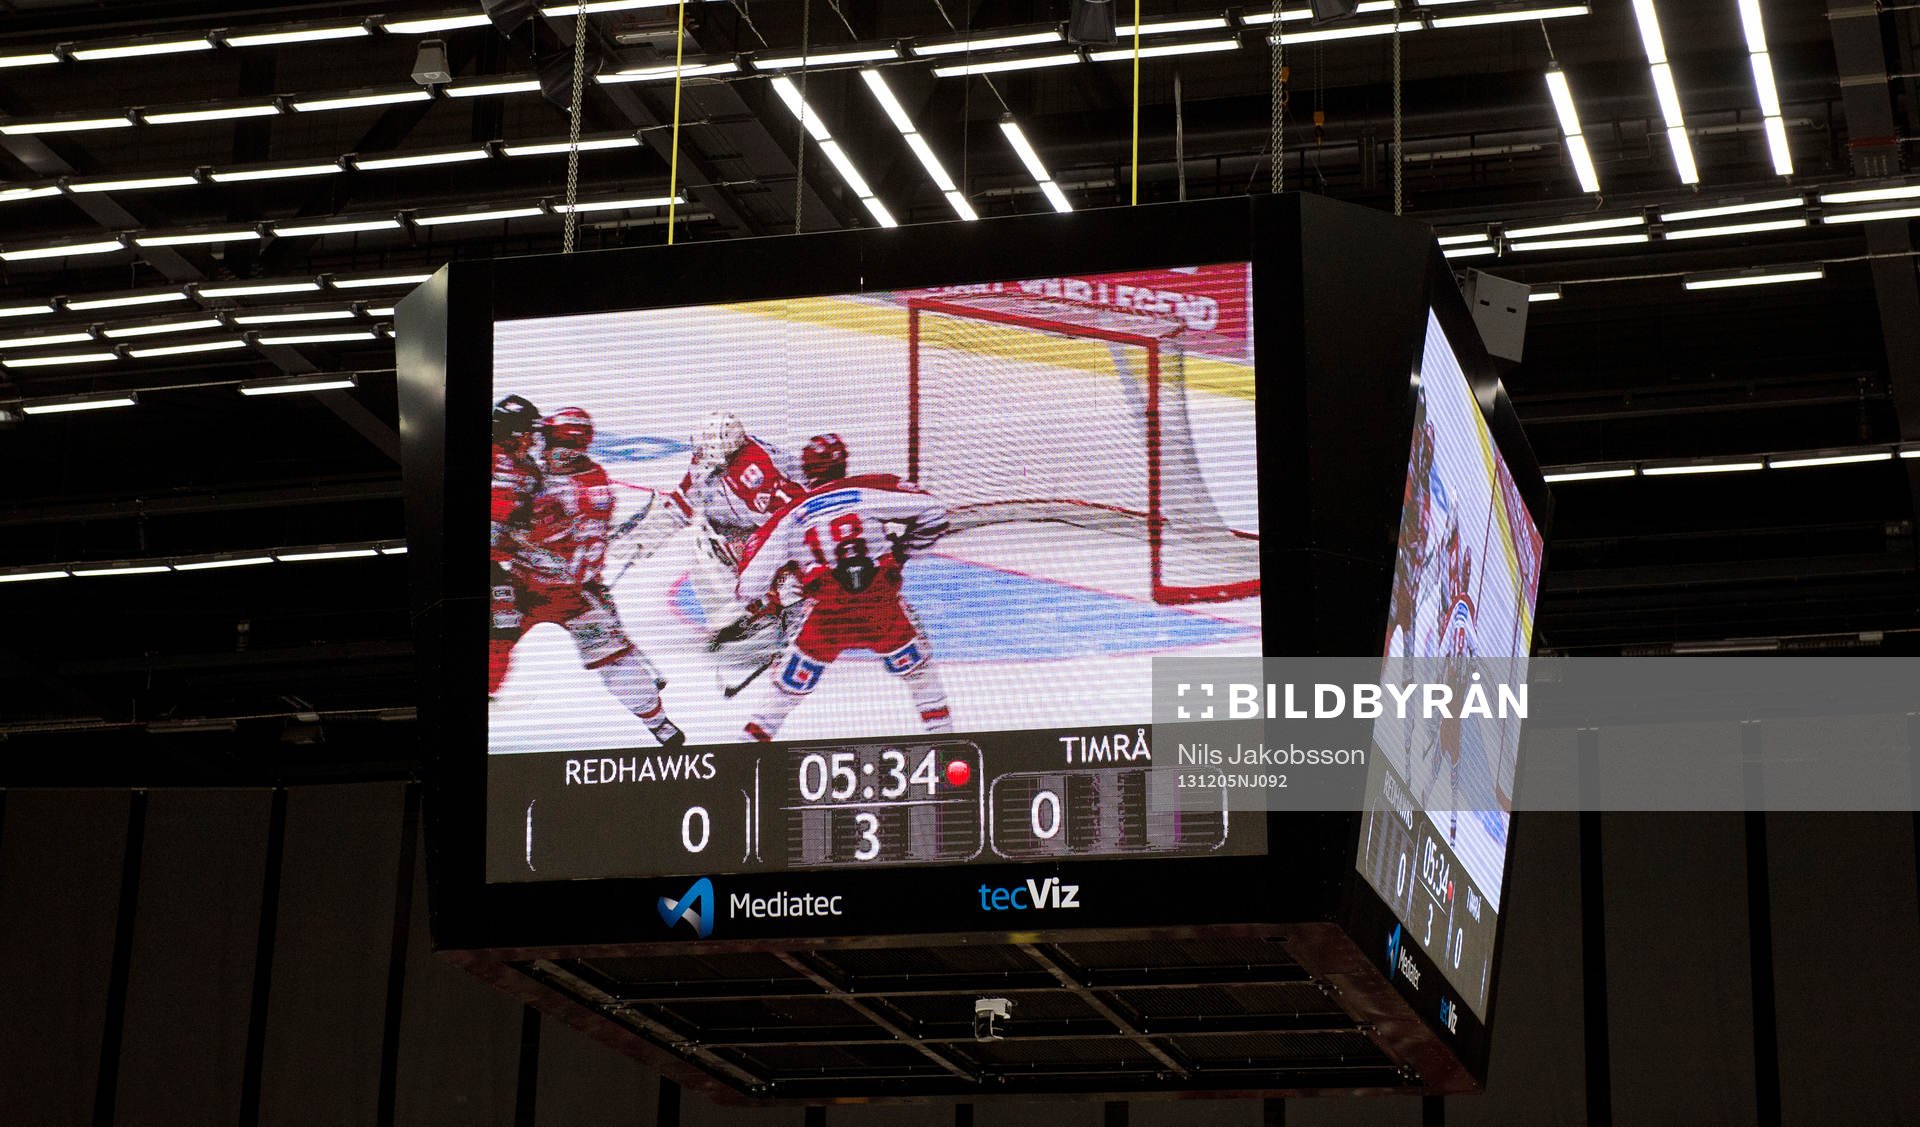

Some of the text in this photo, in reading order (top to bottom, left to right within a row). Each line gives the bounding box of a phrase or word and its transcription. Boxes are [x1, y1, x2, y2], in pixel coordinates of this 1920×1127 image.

[565, 752, 717, 786] REDHAWKS
[1059, 728, 1152, 764] TIMRÅ
[798, 750, 940, 801] 05:34
[681, 806, 710, 853] 0
[854, 812, 881, 861] 3
[1031, 790, 1061, 839] 0
[1423, 836, 1450, 904] 05:34
[730, 892, 842, 919] Mediatec
[978, 877, 1080, 911] tecViz
